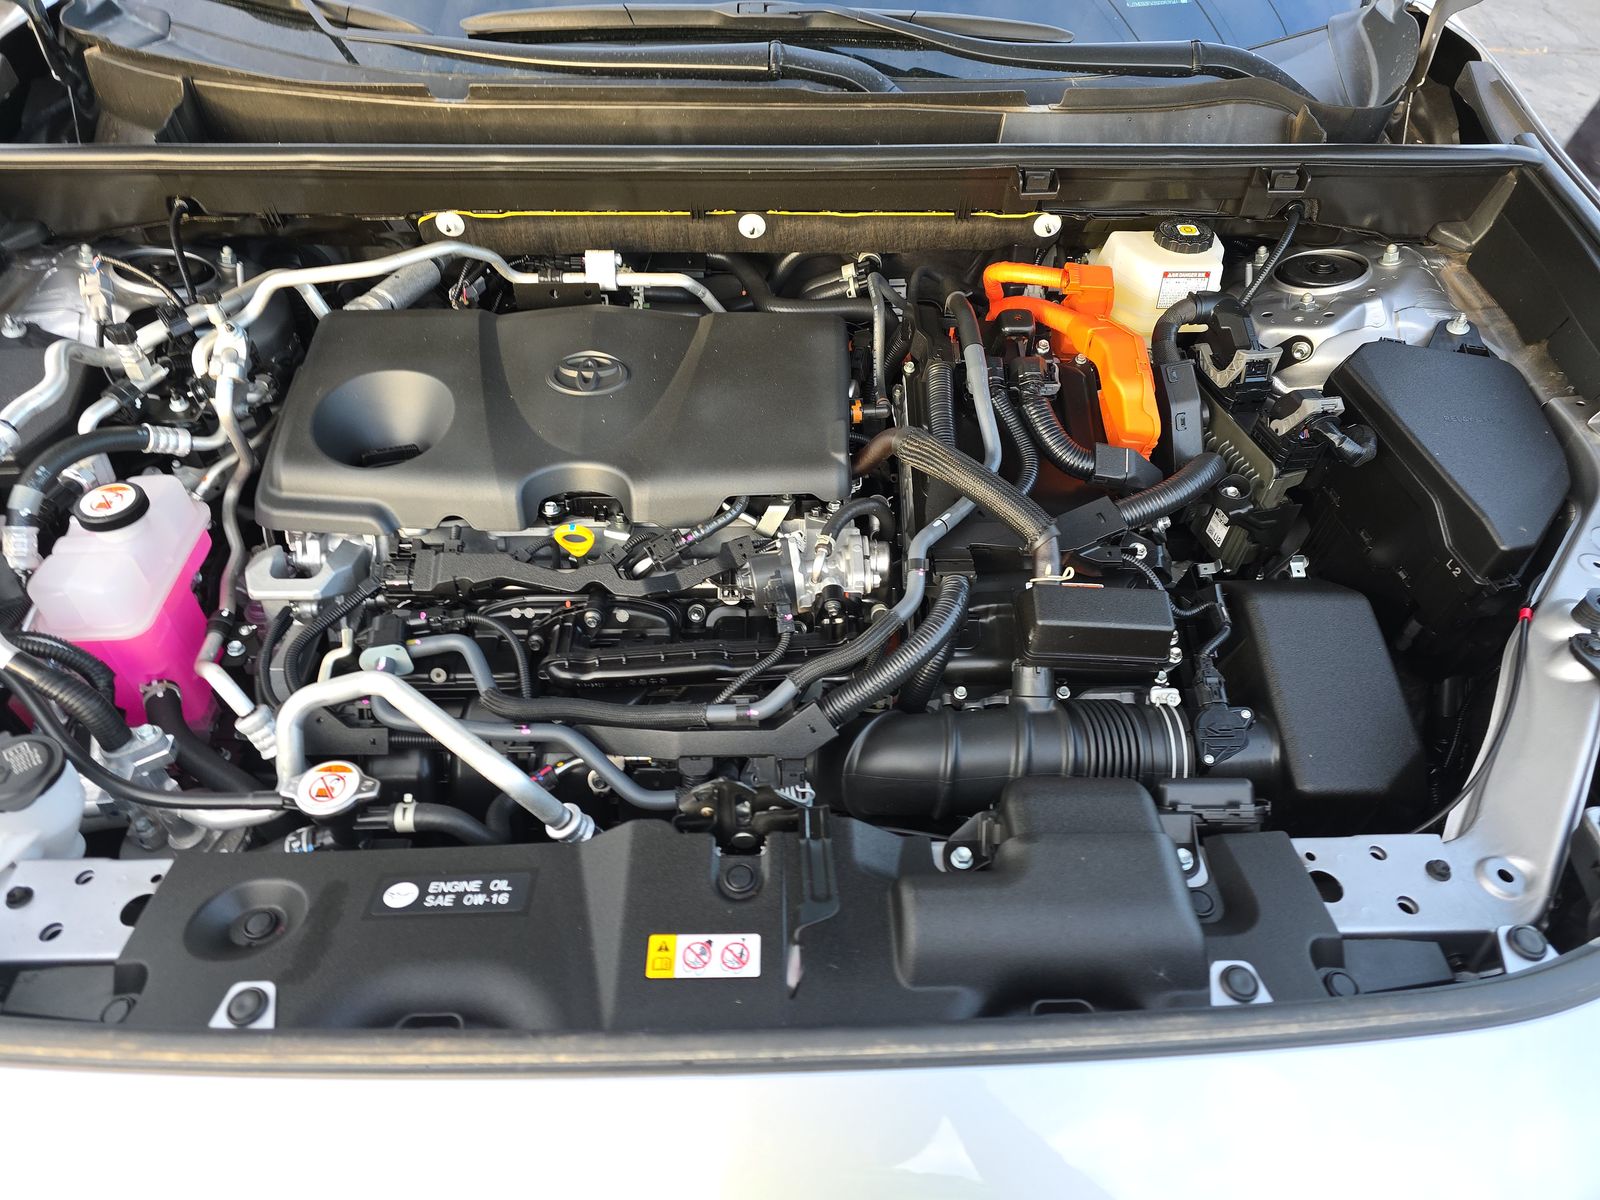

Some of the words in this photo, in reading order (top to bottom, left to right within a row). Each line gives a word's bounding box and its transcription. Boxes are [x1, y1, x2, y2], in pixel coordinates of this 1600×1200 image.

[428, 880, 483, 893] ENGINE
[489, 879, 512, 891] OIL
[423, 894, 456, 907] SAE
[462, 892, 510, 906] 0W-16
